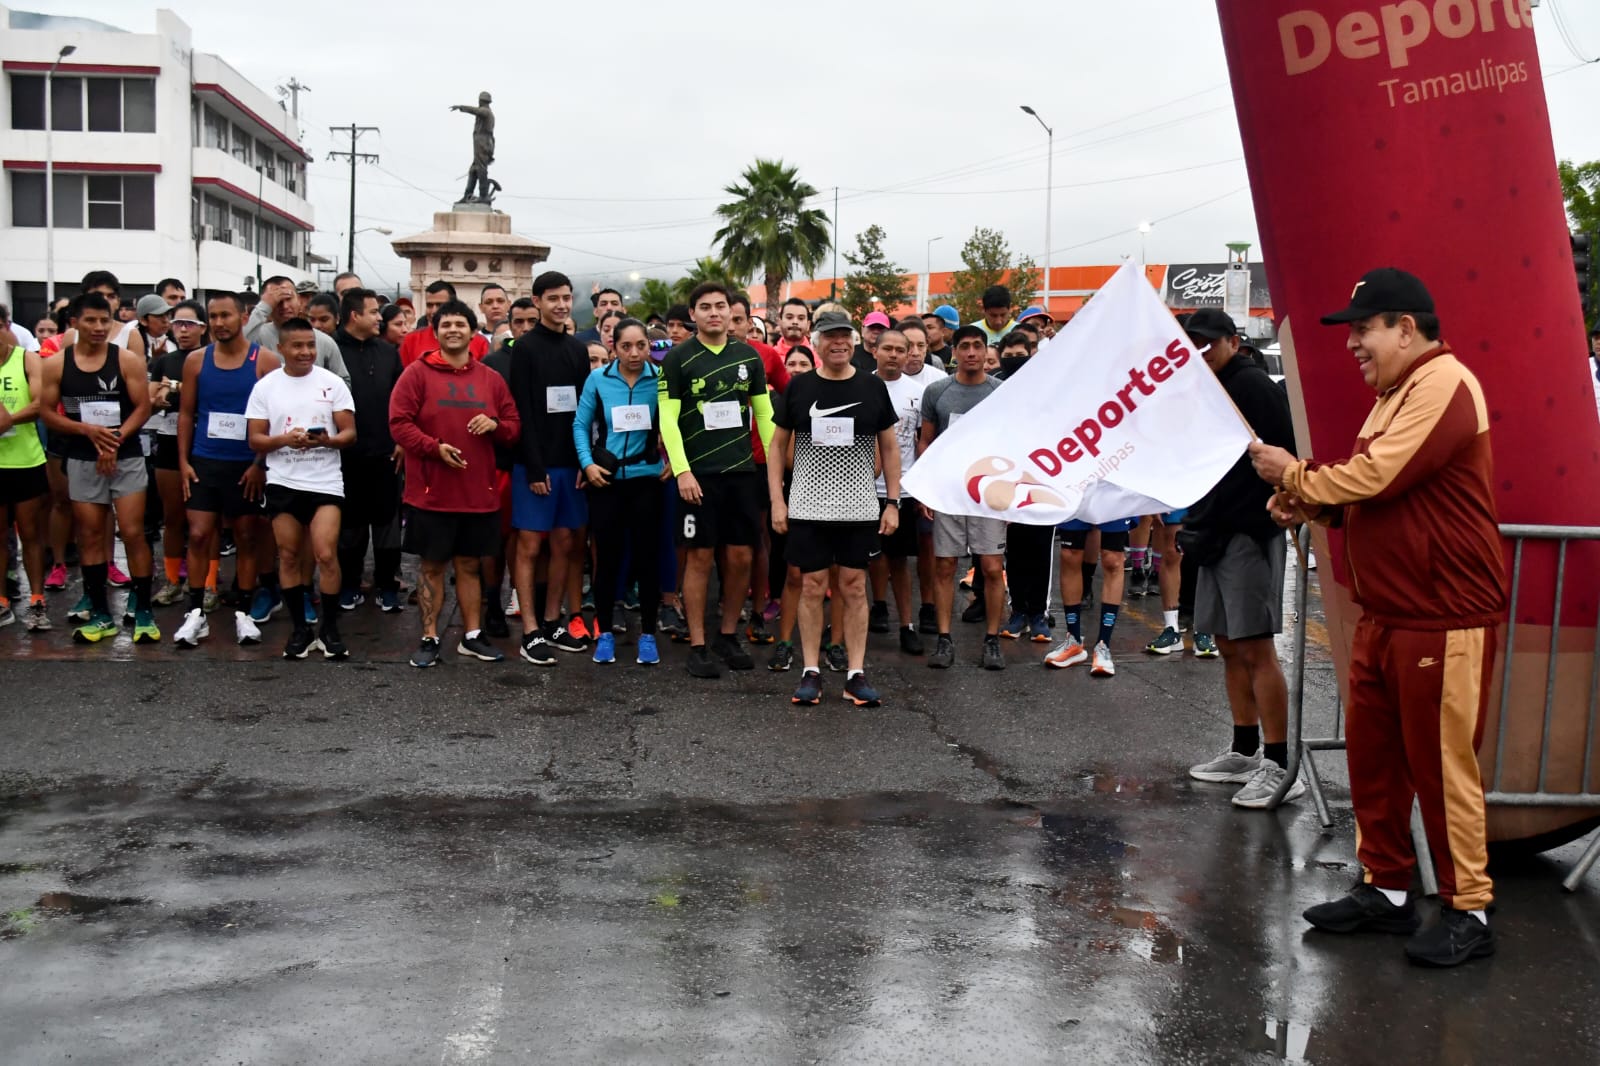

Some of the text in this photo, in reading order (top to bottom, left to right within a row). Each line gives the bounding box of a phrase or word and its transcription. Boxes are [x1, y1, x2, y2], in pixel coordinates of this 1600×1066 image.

[1378, 58, 1528, 107] Tamaulipas
[1172, 267, 1227, 290] Crist
[624, 411, 642, 421] 696
[1028, 338, 1191, 477] Deportes
[825, 426, 842, 434] 501
[684, 513, 696, 538] 6
